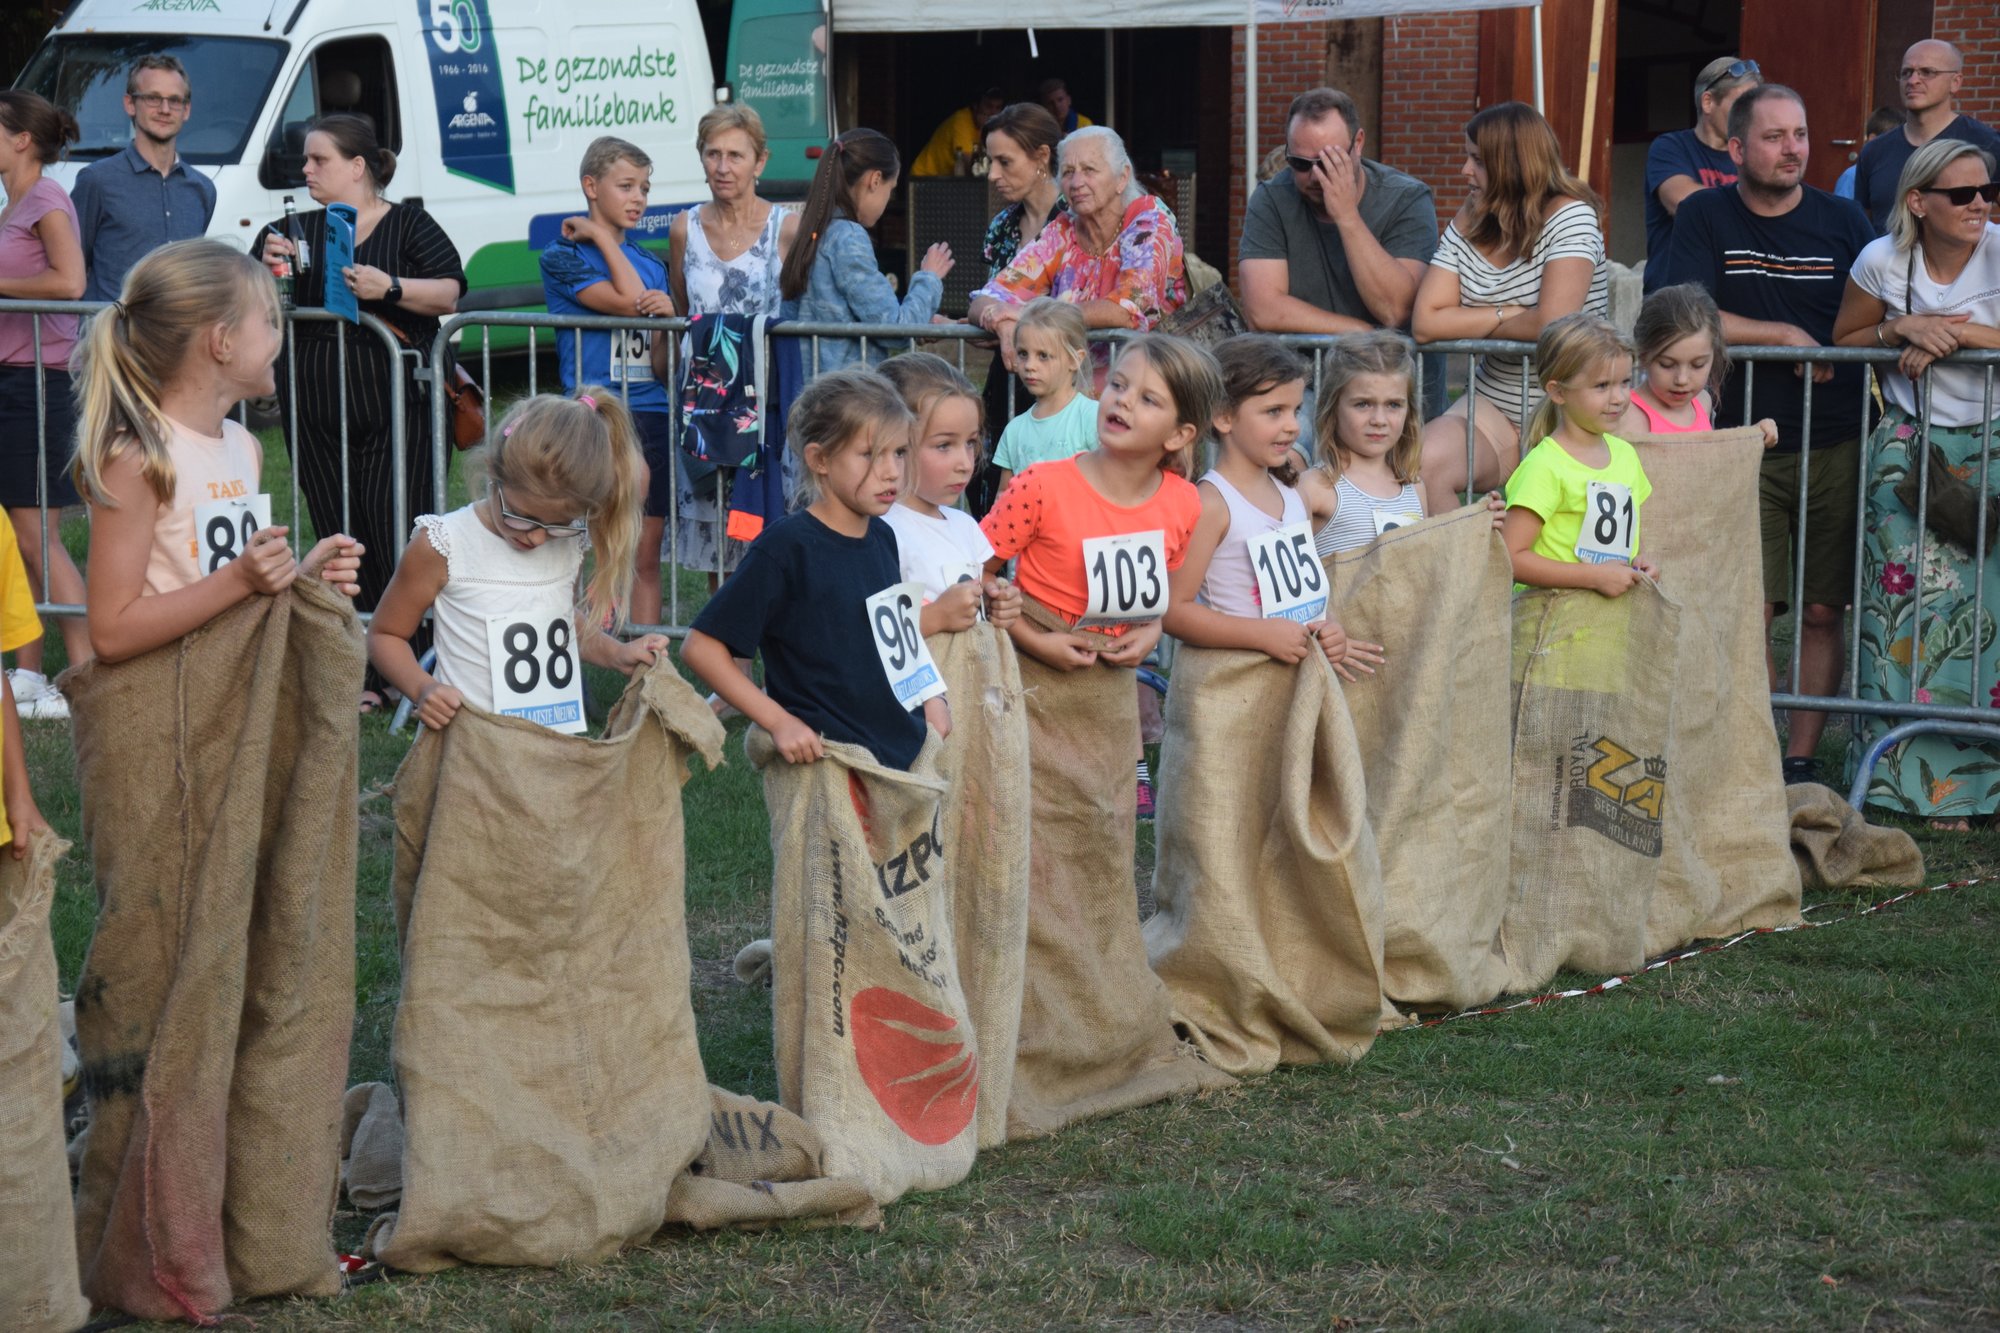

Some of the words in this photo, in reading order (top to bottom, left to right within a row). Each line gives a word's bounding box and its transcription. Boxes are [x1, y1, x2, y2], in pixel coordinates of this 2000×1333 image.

[430, 0, 482, 53] 50
[438, 64, 459, 75] 1966
[467, 63, 488, 74] 2016
[516, 56, 548, 84] De
[555, 44, 677, 93] gezondste
[739, 63, 753, 78] De
[755, 57, 818, 82] gezondste
[739, 80, 815, 99] familiebank
[448, 112, 496, 128] ARGENTA
[522, 91, 677, 143] familiebank
[1594, 491, 1633, 549] 81
[1092, 545, 1161, 614] 103
[1258, 533, 1321, 604] 105
[502, 618, 573, 694] 88
[874, 593, 919, 671] 96
[1569, 731, 1589, 791] ROYAL
[1594, 796, 1618, 820] SEED
[1607, 822, 1657, 855] HOLLAND
[829, 838, 849, 1038] www.hzpc.com
